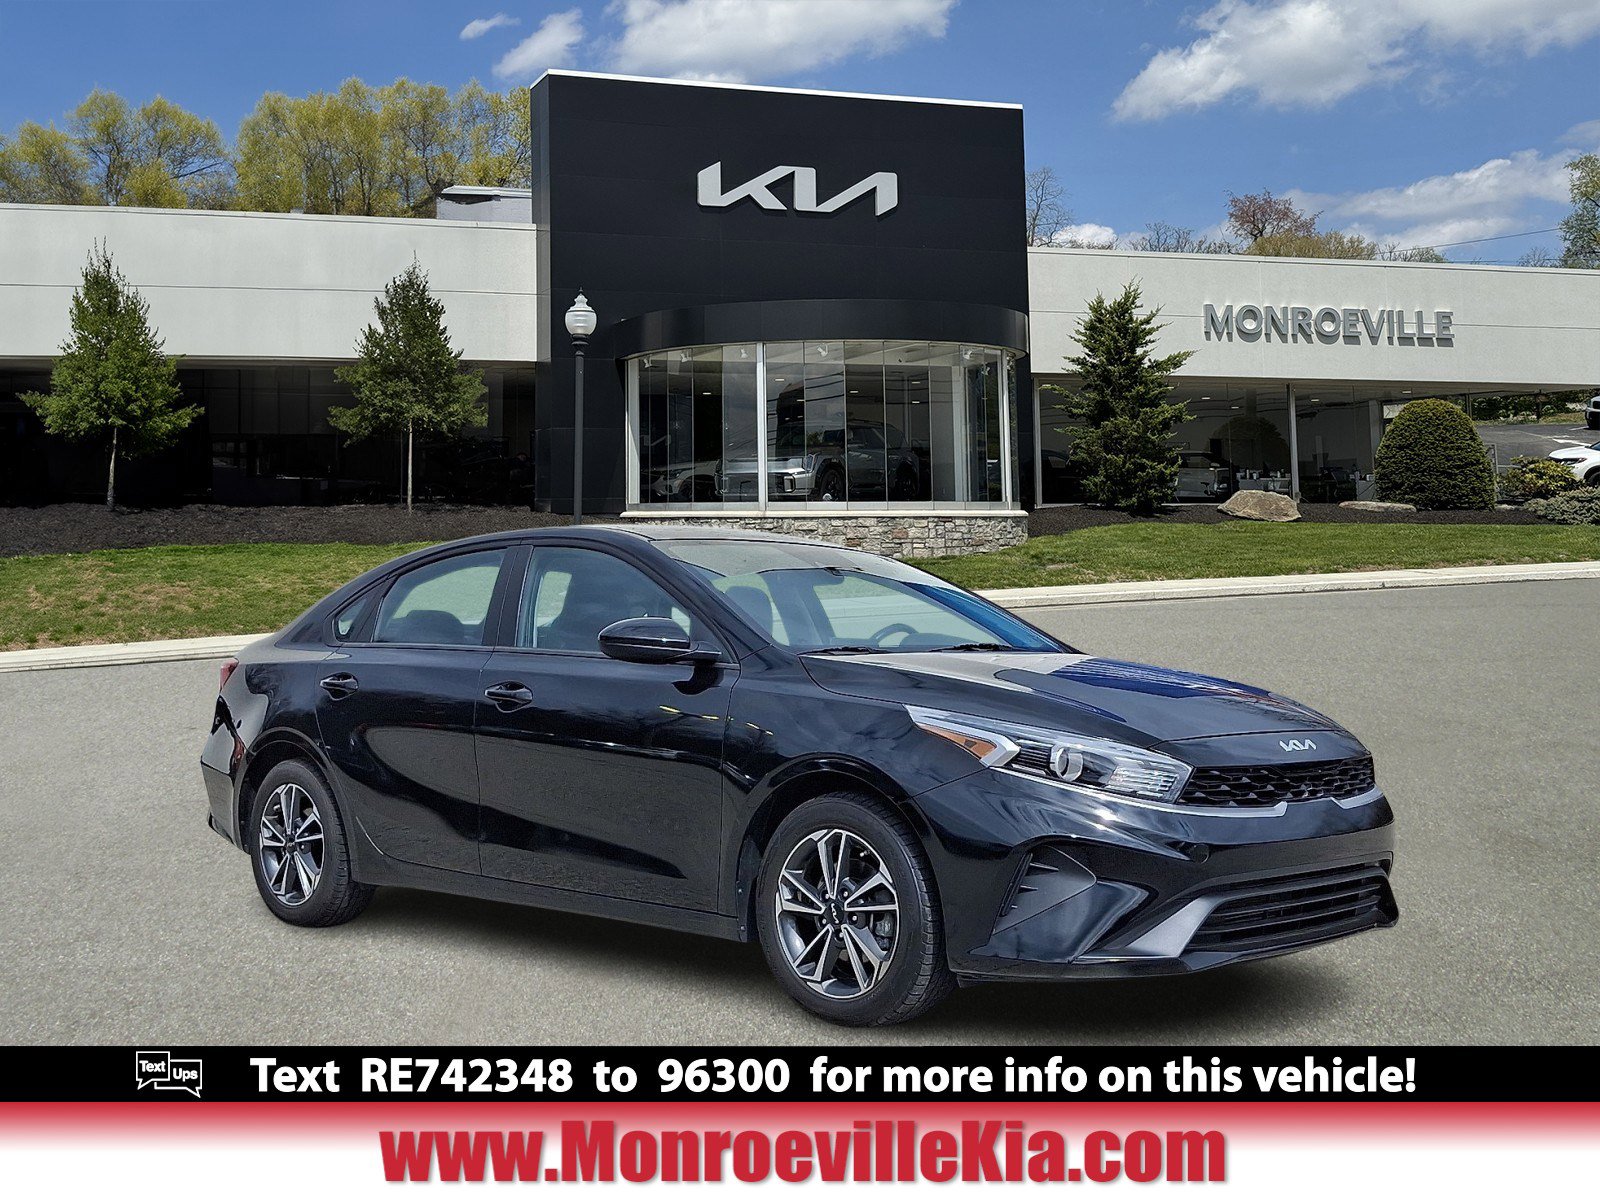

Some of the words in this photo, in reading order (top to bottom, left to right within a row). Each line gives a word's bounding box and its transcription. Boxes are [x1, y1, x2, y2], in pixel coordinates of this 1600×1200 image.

[698, 161, 898, 216] KIA
[1203, 303, 1455, 345] MONROEVILLE
[1279, 739, 1317, 752] KIA
